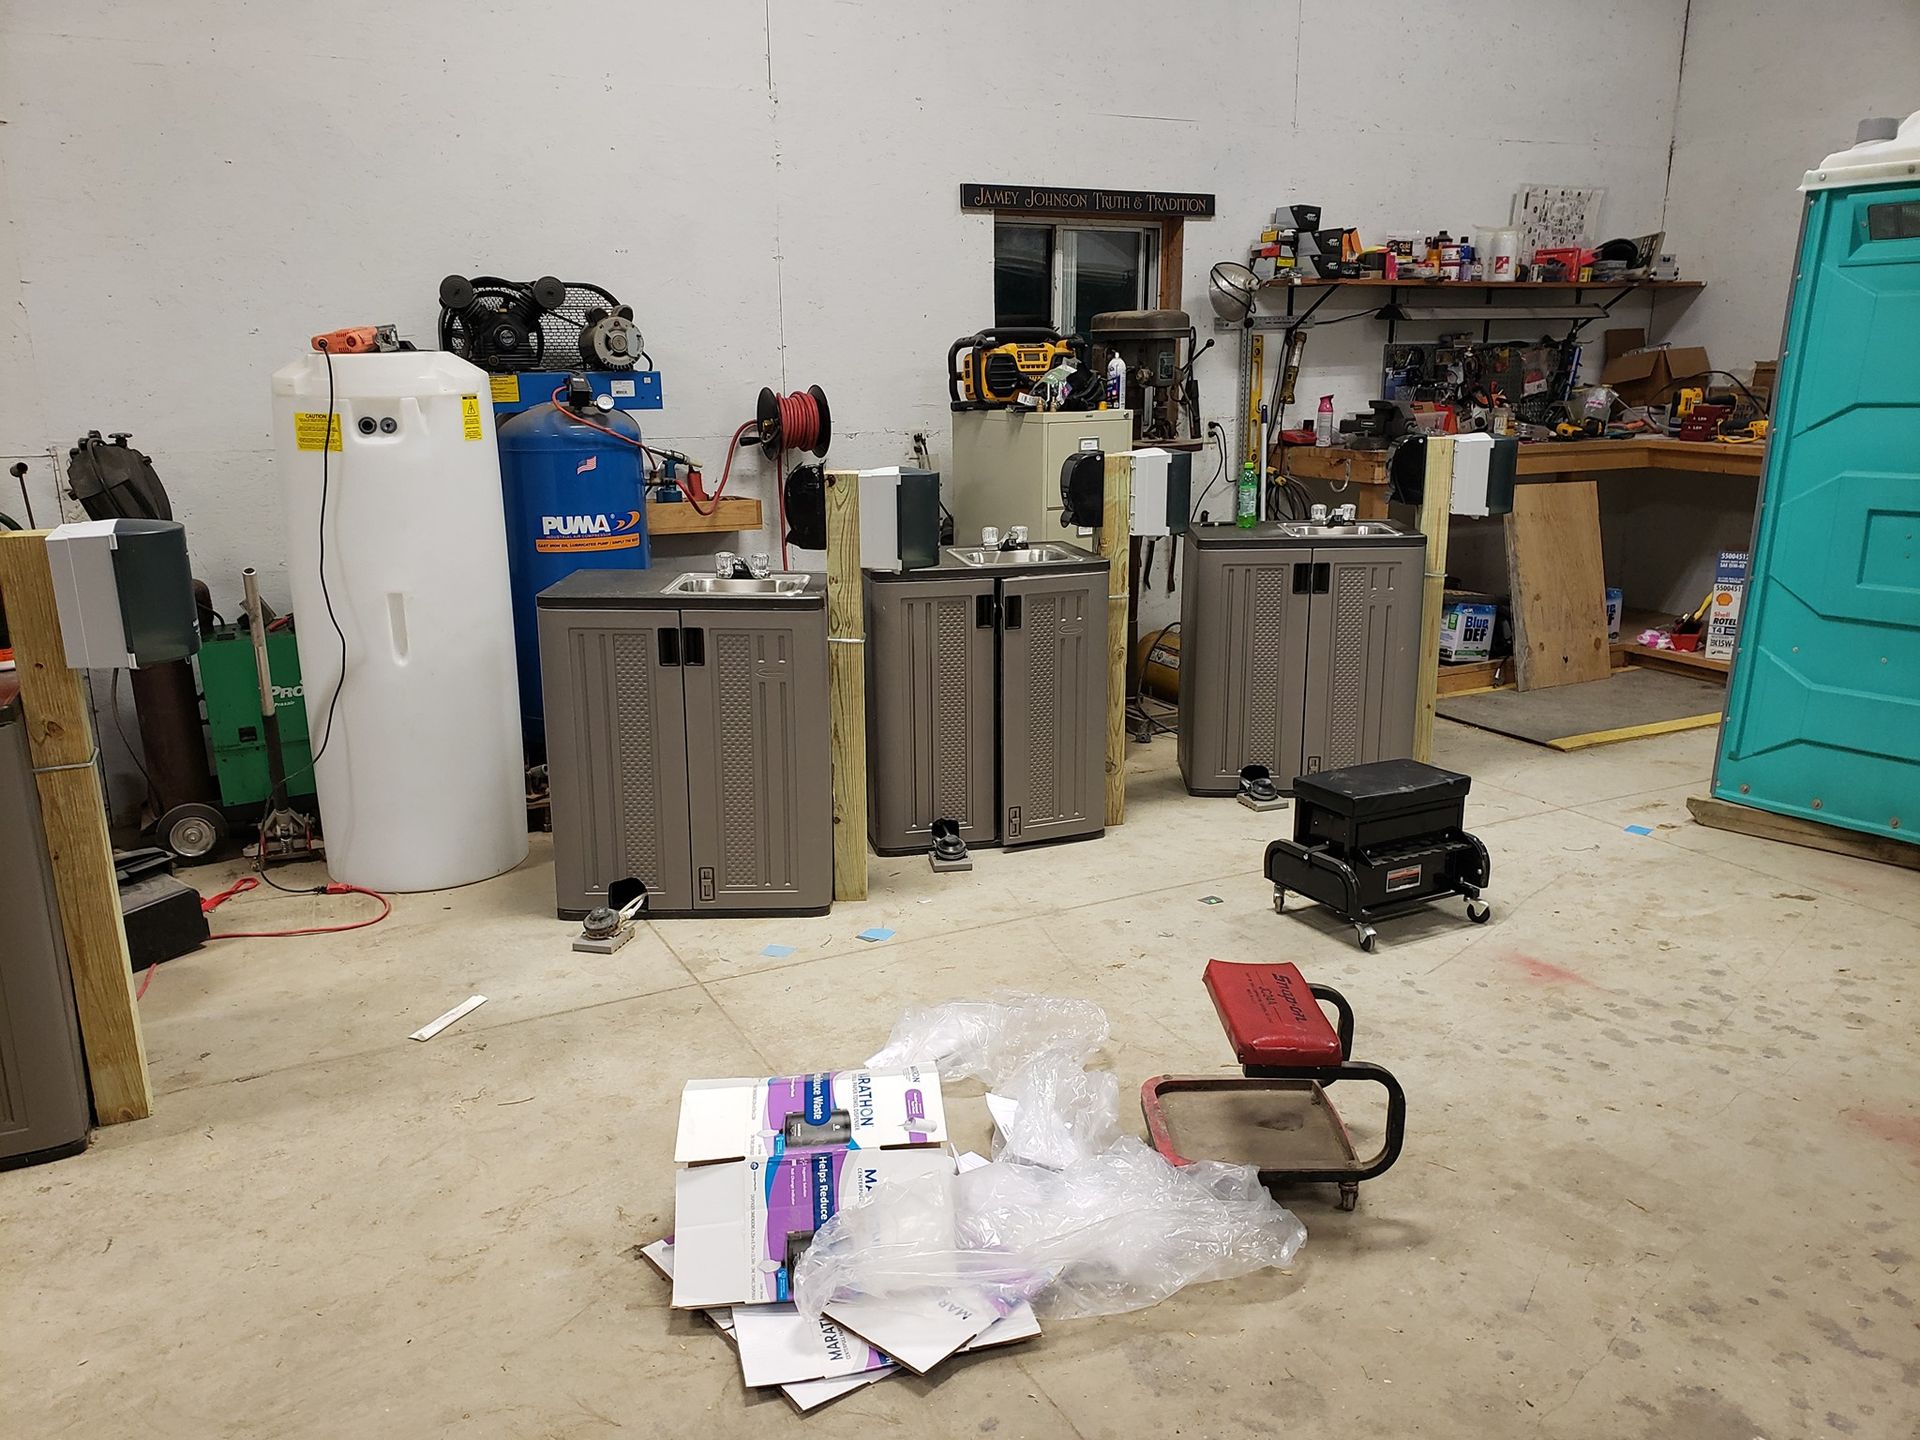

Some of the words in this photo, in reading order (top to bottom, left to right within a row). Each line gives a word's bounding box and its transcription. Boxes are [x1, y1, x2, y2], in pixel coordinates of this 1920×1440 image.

[974, 187, 1019, 205] JAMEY
[1024, 189, 1088, 208] JOHNSON
[1092, 192, 1130, 210] TRUTH
[1133, 197, 1143, 209] &
[1146, 194, 1207, 212] TRADITION
[542, 515, 611, 535] PUMA
[1463, 629, 1487, 641] DEF
[1465, 616, 1489, 630] Blue
[813, 1095, 823, 1120] Waste
[819, 1156, 828, 1186] Helps
[820, 1185, 830, 1220] Reduce
[819, 1318, 843, 1361] MARAT
